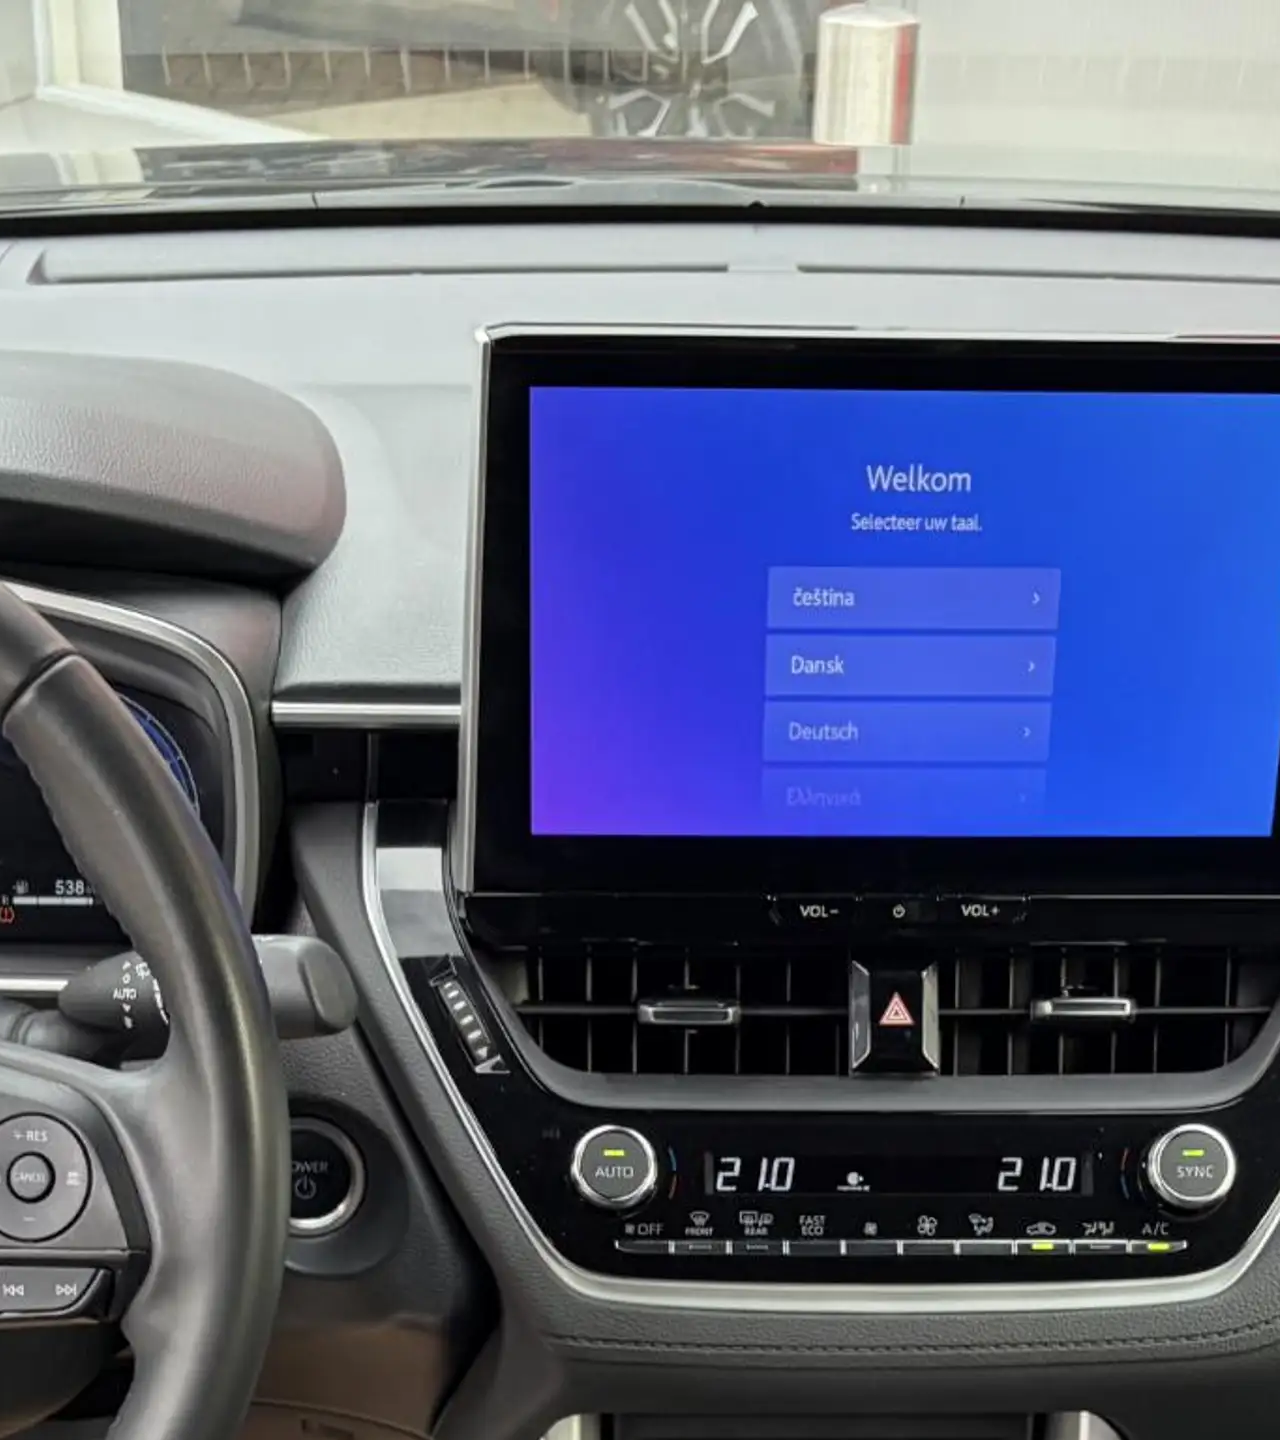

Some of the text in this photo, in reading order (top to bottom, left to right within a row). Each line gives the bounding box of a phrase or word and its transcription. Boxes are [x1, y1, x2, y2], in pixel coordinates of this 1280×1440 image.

[866, 464, 972, 493] Welkom
[851, 511, 983, 532] Selecteer uw taal.
[792, 586, 856, 607] čeština
[790, 655, 844, 675] Dansk
[788, 720, 859, 741] Deutsch
[55, 879, 85, 896] 538
[960, 903, 1001, 918] VOL+
[112, 987, 137, 1001] AUTO
[594, 1165, 635, 1179] AUTO
[1175, 1165, 1215, 1179] SYNC
[799, 1214, 826, 1226] FAST
[638, 1223, 665, 1236] OFF
[685, 1226, 714, 1237] FRONT
[744, 1226, 769, 1237] REAR
[800, 1225, 824, 1237] ECO
[1141, 1222, 1170, 1236] A/C
